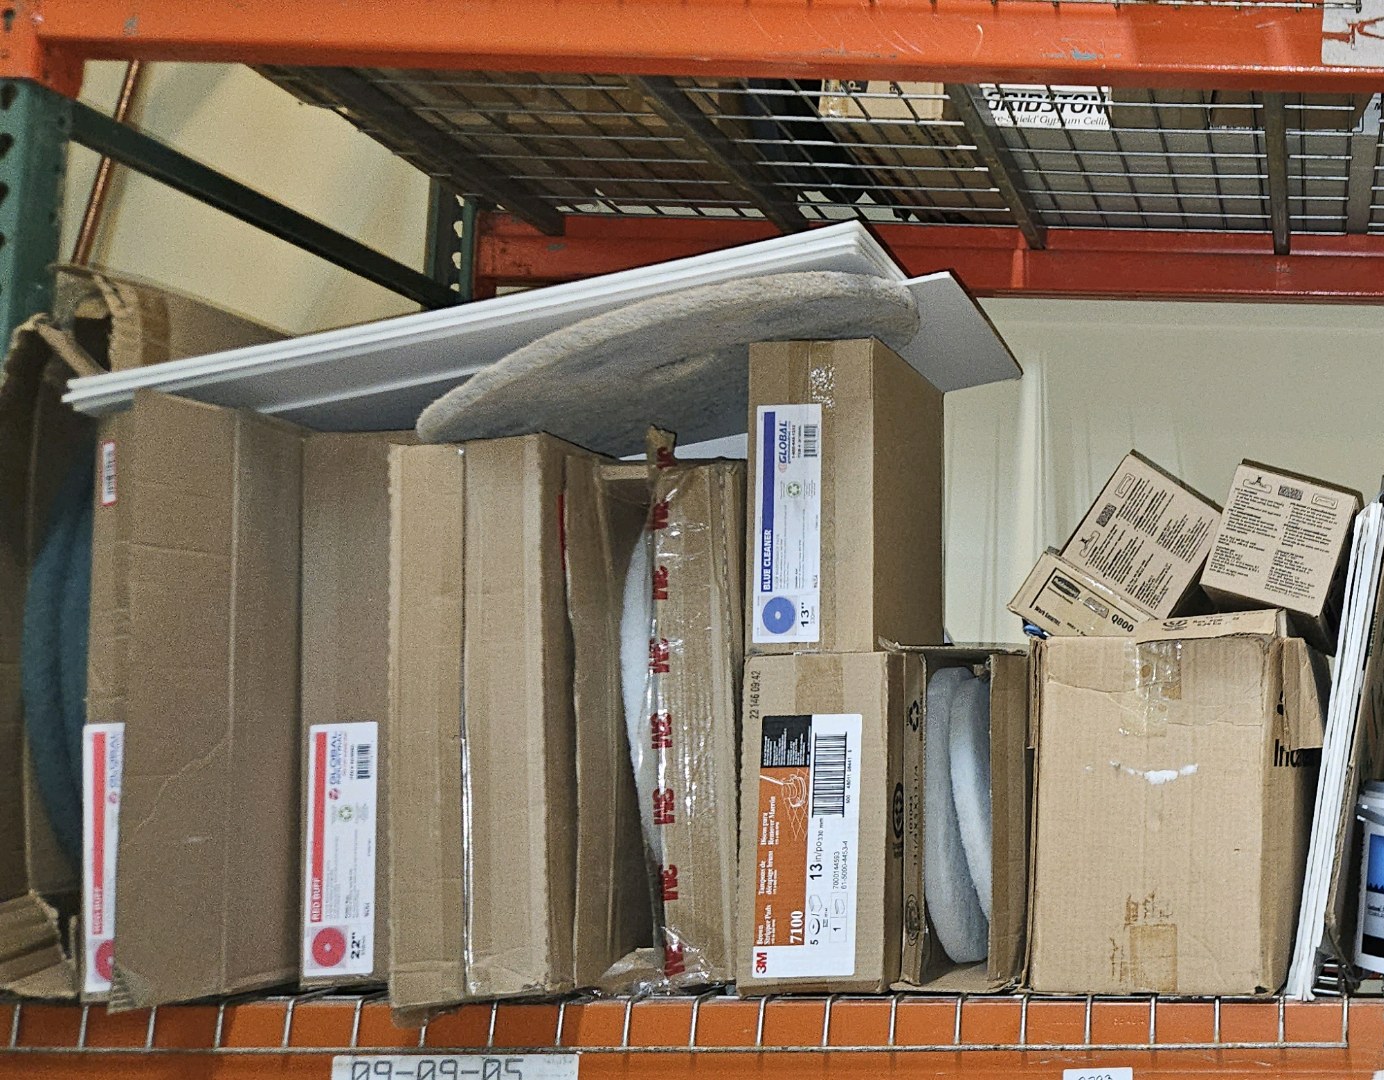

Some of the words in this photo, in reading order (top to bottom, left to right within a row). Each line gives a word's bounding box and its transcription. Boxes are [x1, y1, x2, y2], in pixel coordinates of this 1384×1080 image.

[1040, 115, 1080, 126] Gypum
[779, 421, 787, 464] GLOBAL
[763, 529, 772, 567] CLEANER
[763, 569, 771, 591] BLUE
[651, 712, 673, 750] 3M
[652, 787, 676, 825] 3M
[813, 841, 824, 863] in/po
[809, 863, 823, 881] 13
[312, 878, 321, 900] BUFF
[311, 902, 320, 921] RED
[765, 920, 773, 945] Stripper
[790, 910, 804, 944] 7100
[756, 952, 768, 975] 3M
